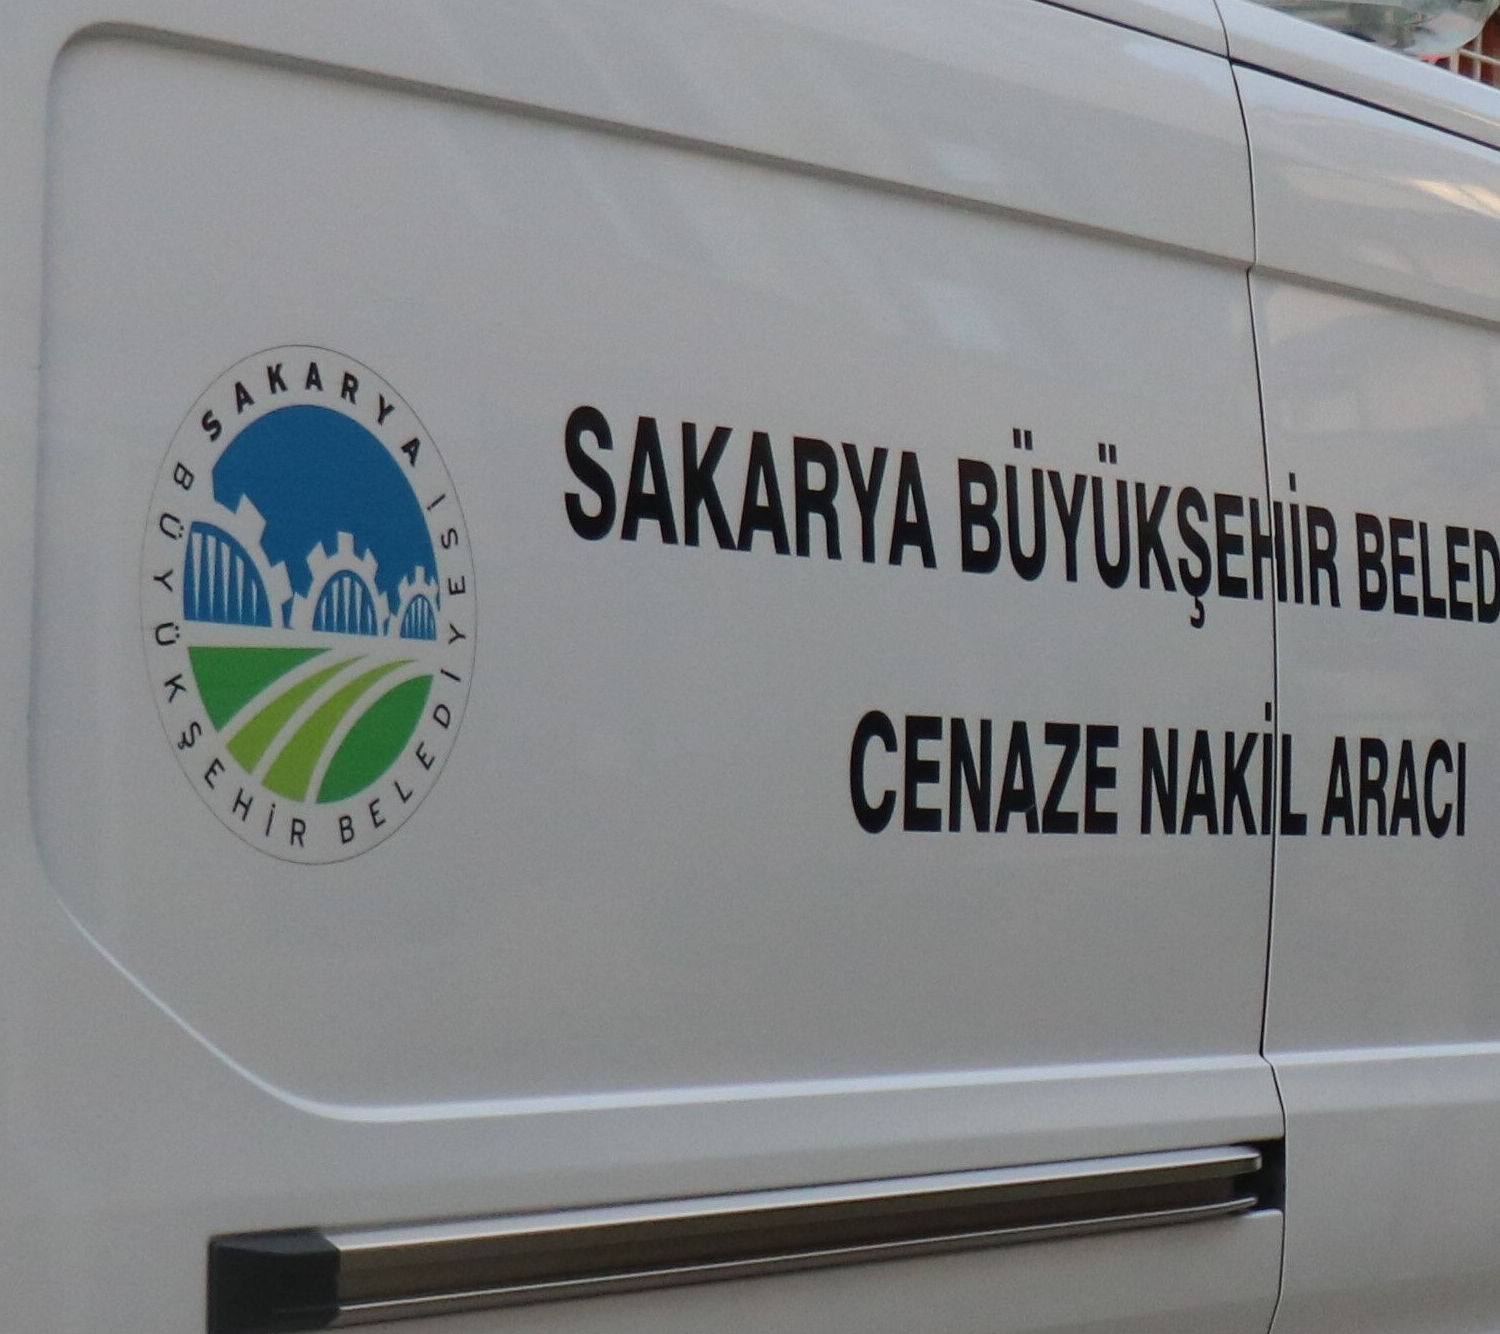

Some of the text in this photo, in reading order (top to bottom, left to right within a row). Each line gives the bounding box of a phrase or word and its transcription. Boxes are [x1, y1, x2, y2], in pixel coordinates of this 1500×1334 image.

[200, 361, 421, 467] SAKARYA
[563, 404, 938, 570] SAKARYA
[956, 427, 1342, 630] BÜYÜKŞEHİR
[153, 462, 467, 848] BÜYÜKŞEHİR BELEDİYESİ
[848, 700, 1468, 840] CENAZE NAKİL ARACI
